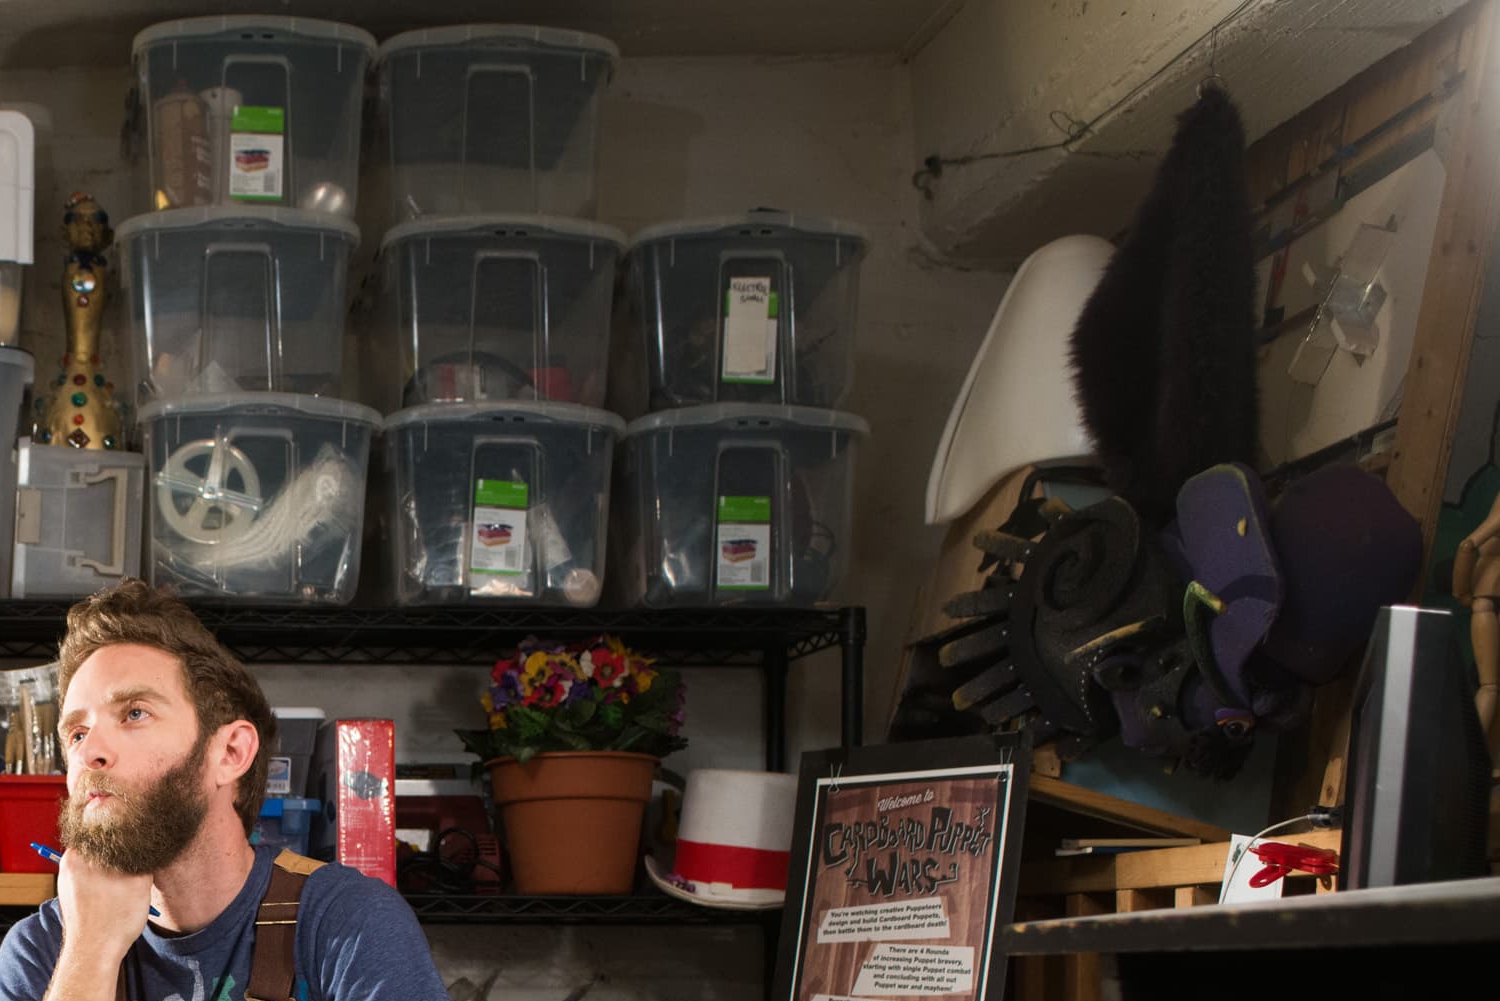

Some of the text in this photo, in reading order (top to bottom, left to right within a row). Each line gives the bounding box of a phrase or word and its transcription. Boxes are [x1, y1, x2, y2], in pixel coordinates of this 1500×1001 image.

[878, 788, 934, 811] Welcome to
[823, 807, 993, 874] CARDBOARD PUPPET
[859, 852, 950, 897] WARS
